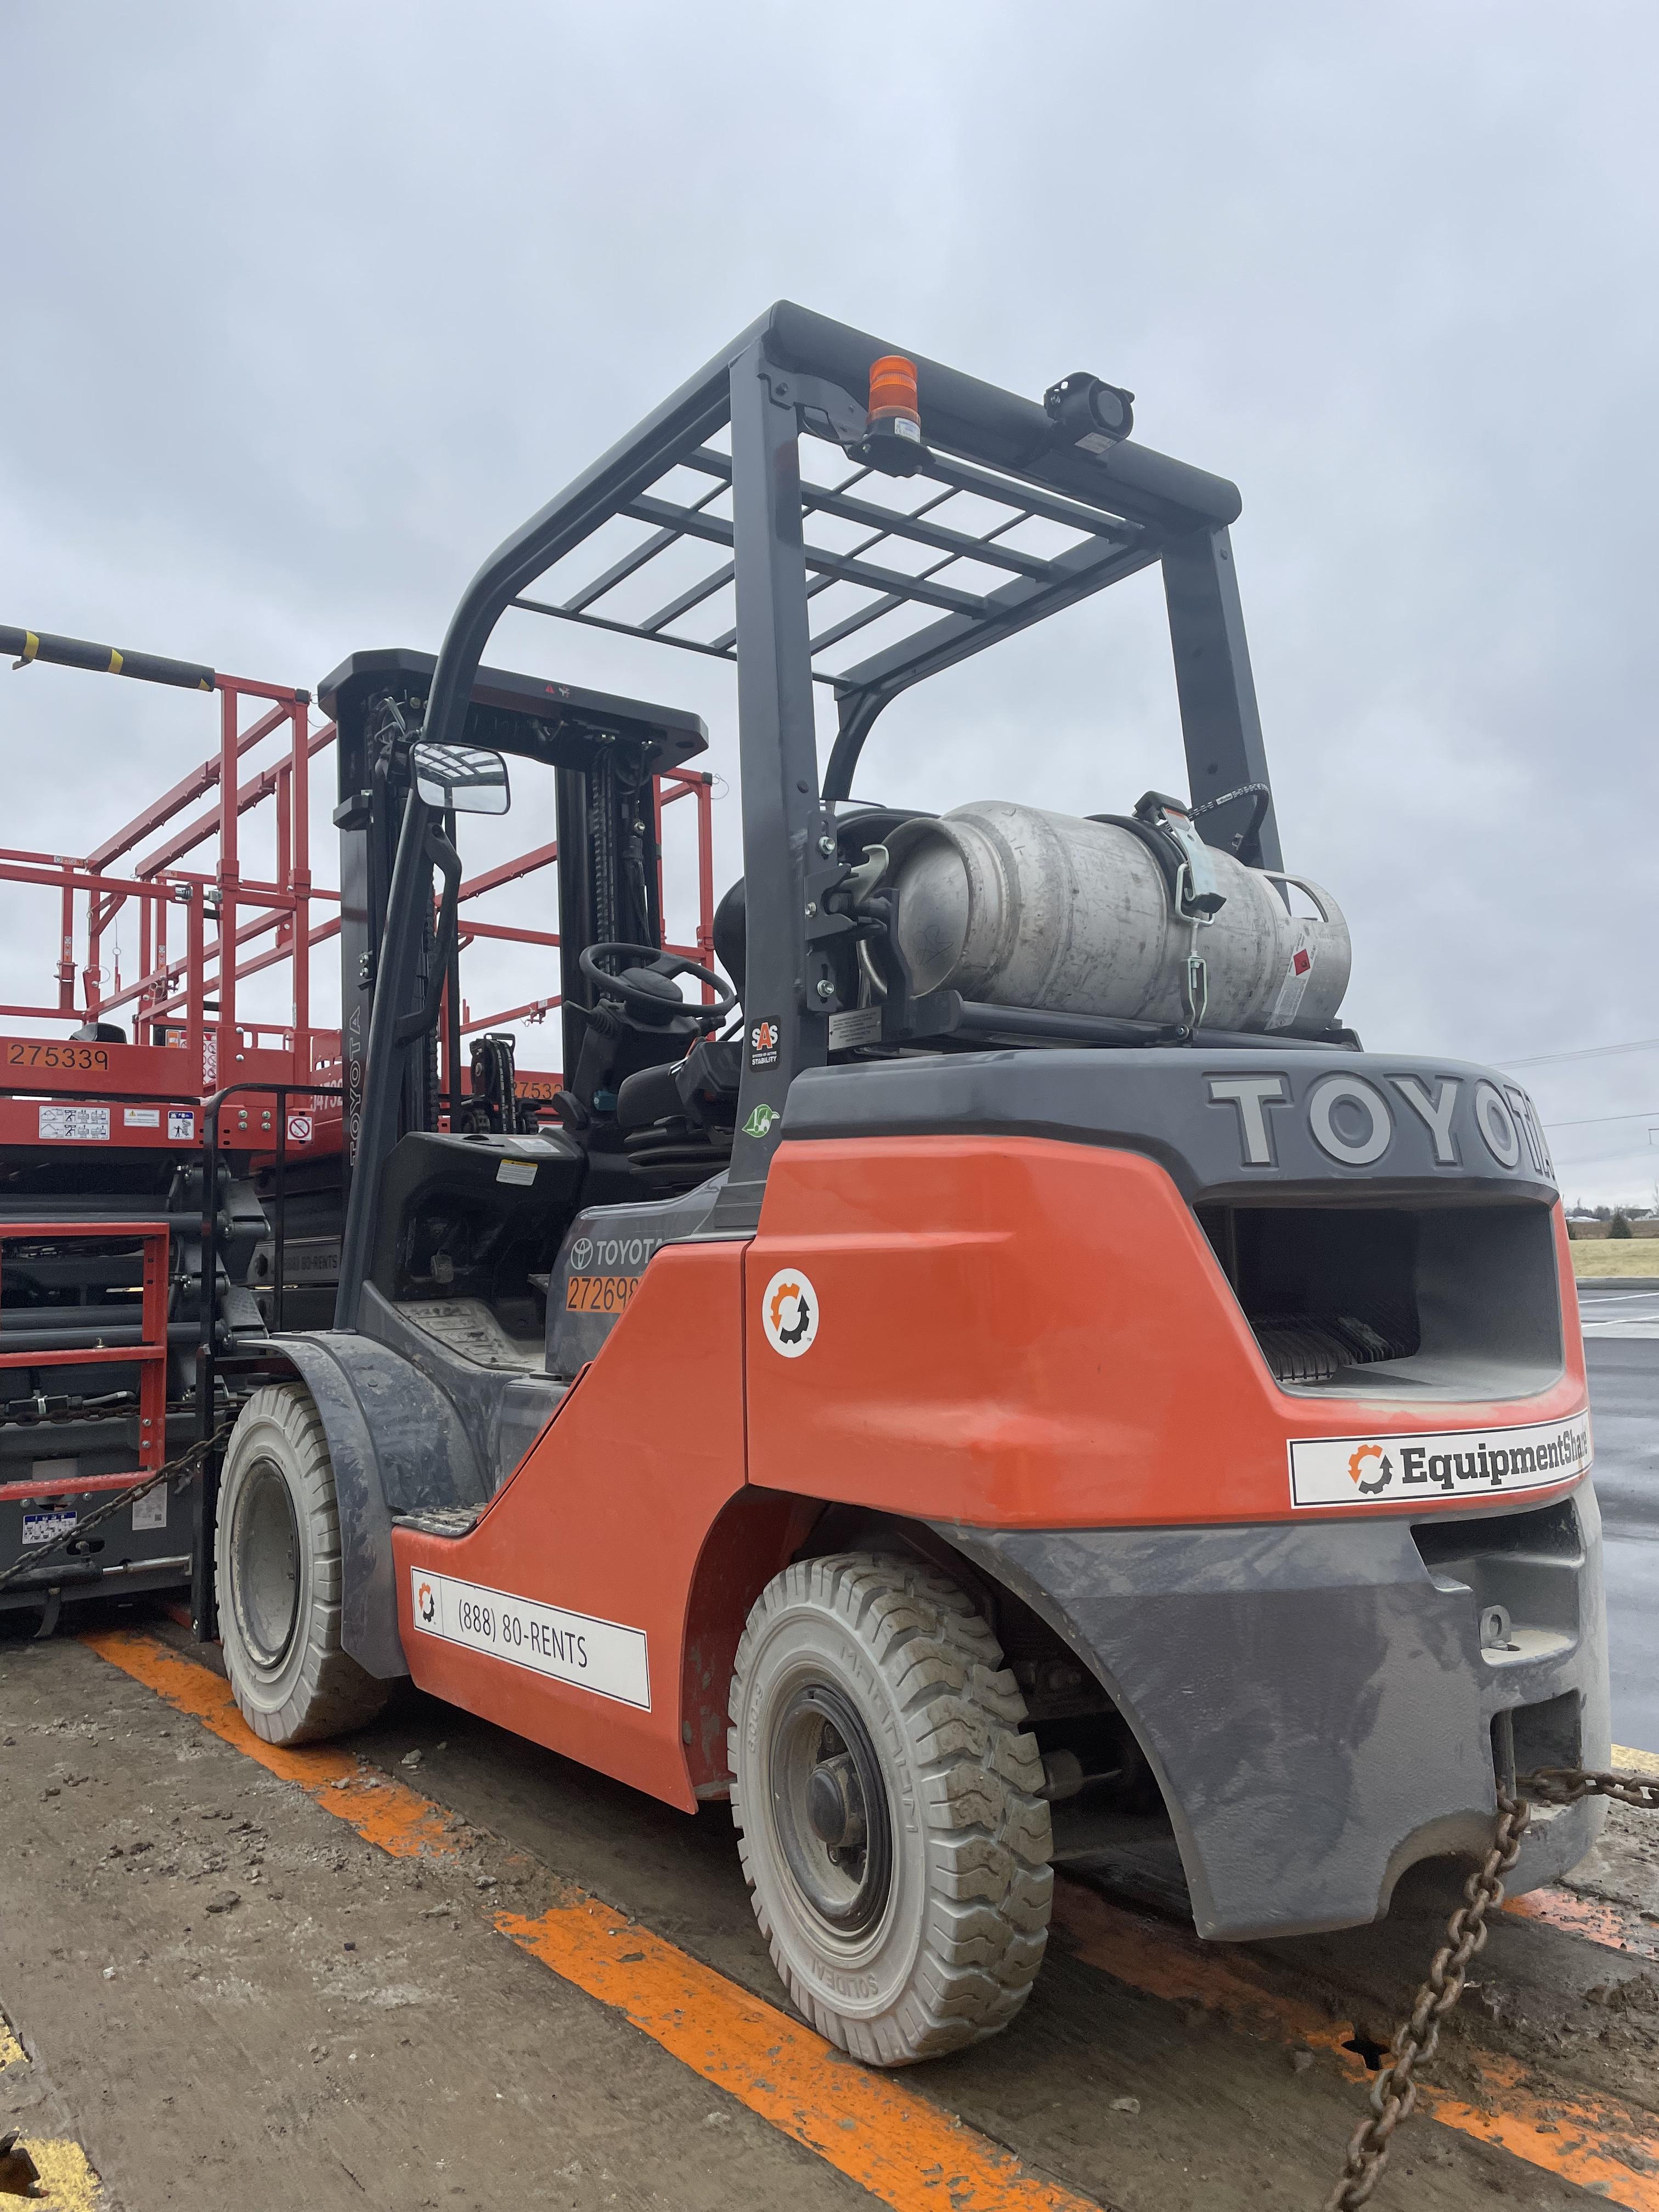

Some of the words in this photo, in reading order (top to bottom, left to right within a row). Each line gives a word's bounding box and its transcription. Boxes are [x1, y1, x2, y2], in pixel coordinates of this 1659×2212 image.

[751, 1022, 778, 1050] SAS
[9, 1044, 108, 1070] 275339
[752, 1056, 777, 1065] STABILITY
[349, 1006, 361, 1166] TOYOTA
[514, 1081, 563, 1099] 753
[1210, 1079, 1555, 1180] TOYOTA
[596, 1238, 663, 1265] TOYOT
[459, 1599, 496, 1643] (888)
[503, 1614, 588, 1668] 80-RENTS
